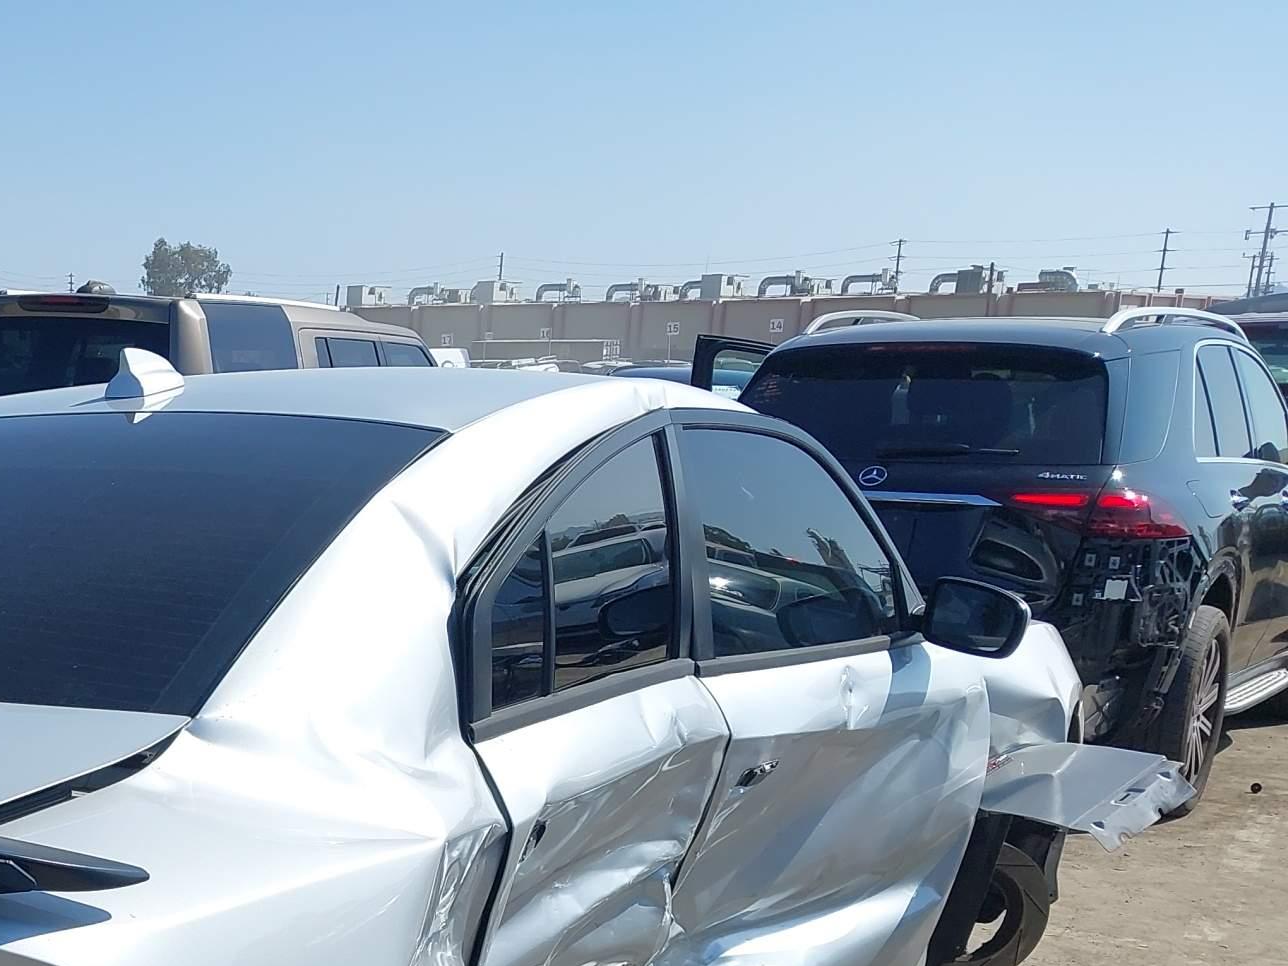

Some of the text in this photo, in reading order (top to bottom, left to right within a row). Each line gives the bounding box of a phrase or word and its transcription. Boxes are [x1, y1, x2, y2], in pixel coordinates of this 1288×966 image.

[667, 324, 679, 333] 15
[771, 321, 782, 331] 14
[1038, 472, 1088, 480] 4MATIC
